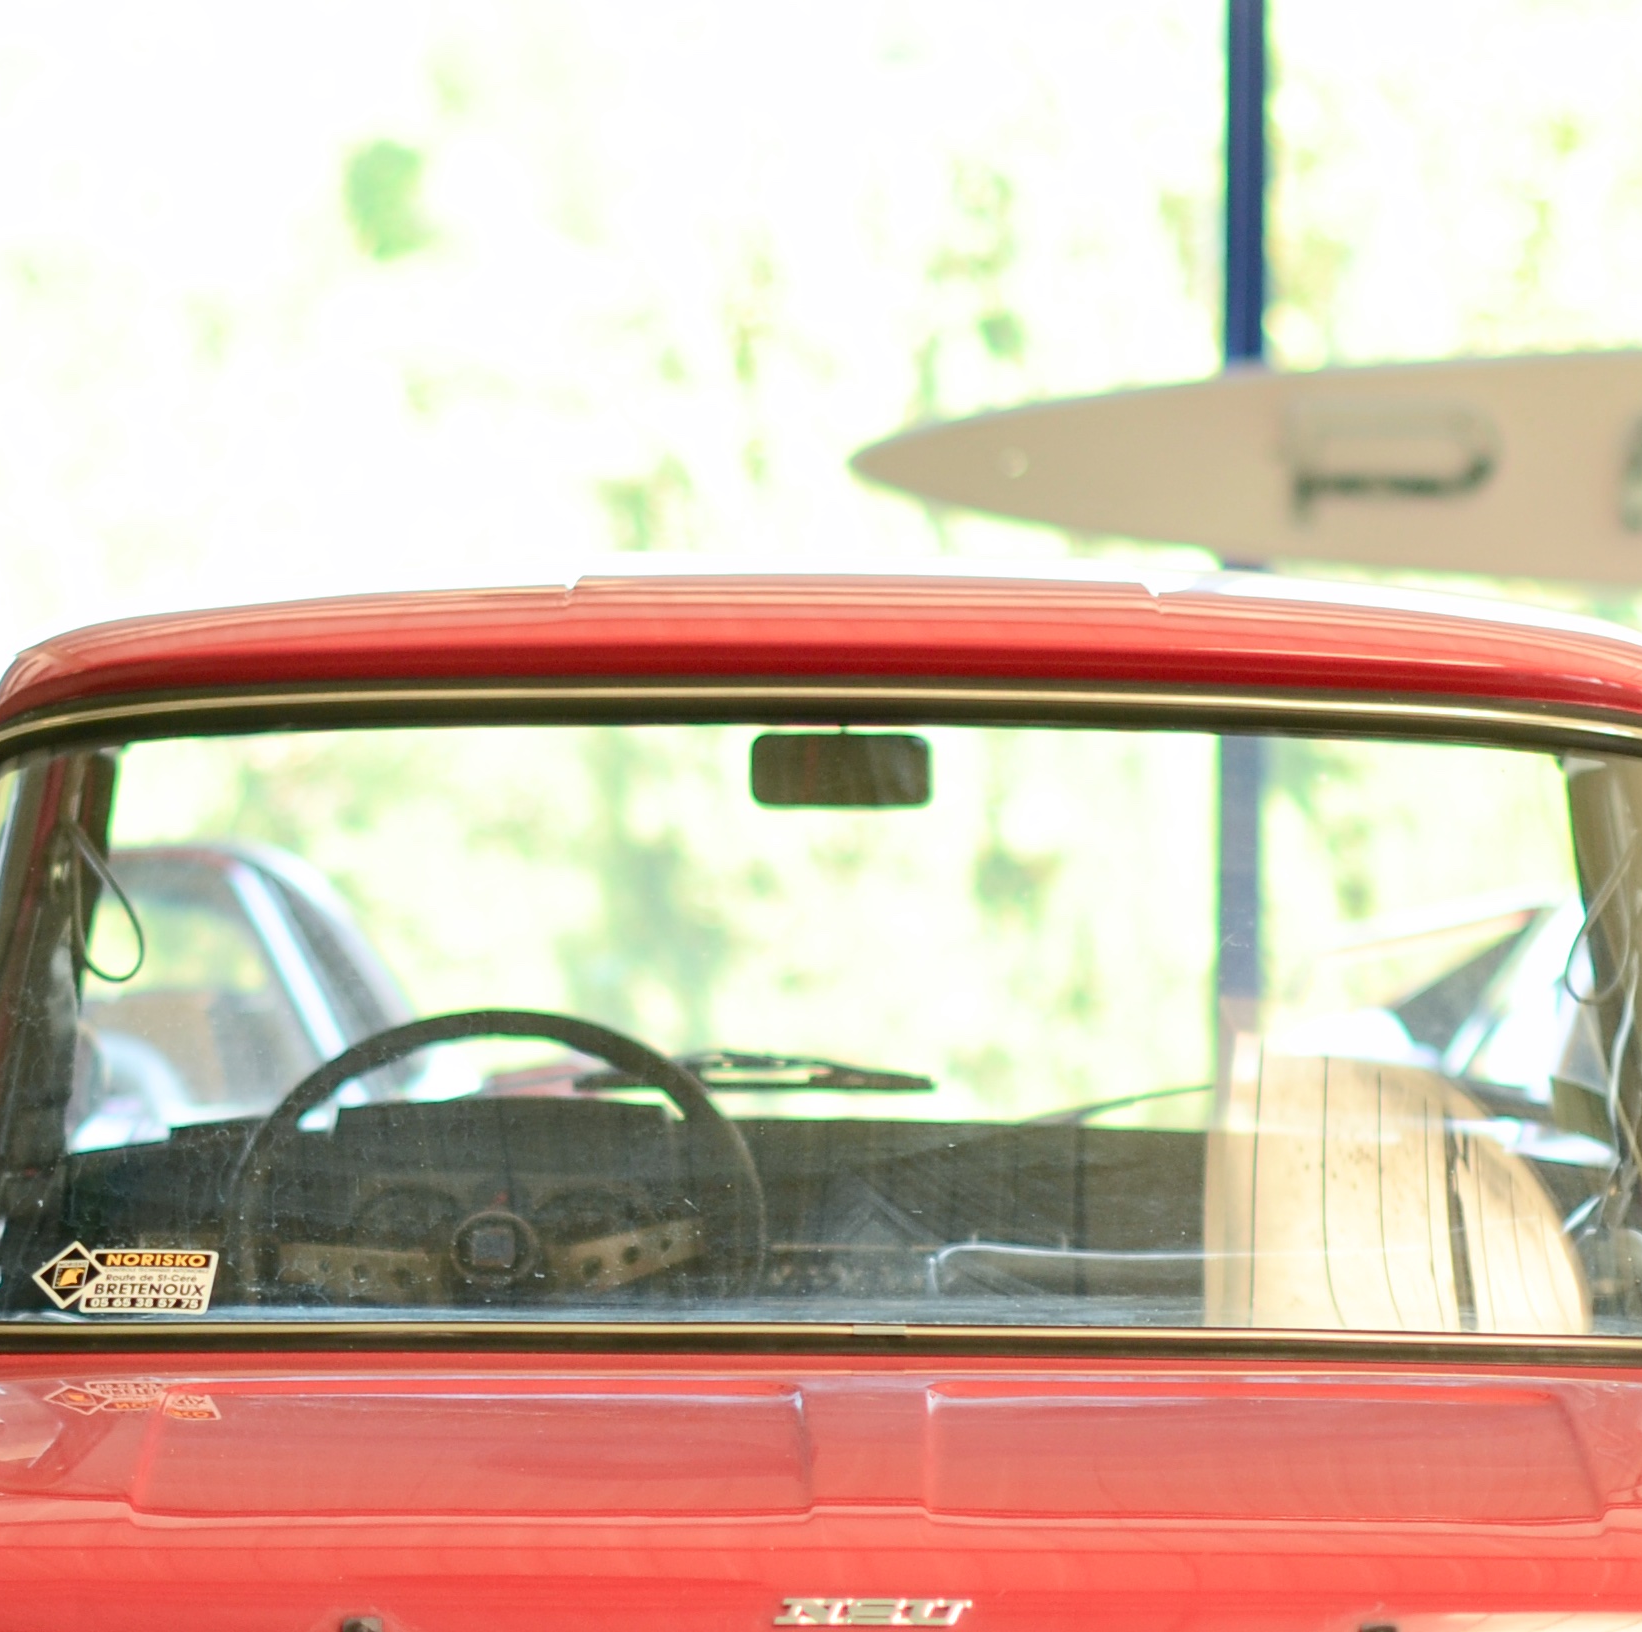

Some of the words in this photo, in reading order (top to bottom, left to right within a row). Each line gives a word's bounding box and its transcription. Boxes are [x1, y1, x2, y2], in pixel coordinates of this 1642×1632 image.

[105, 1254, 206, 1267] NORISKO
[94, 1284, 206, 1297] BRETENOUX
[90, 1298, 109, 1308] 05
[112, 1298, 131, 1308] 65
[135, 1298, 154, 1308] 38
[157, 1299, 177, 1308] 57
[180, 1299, 199, 1309] 75
